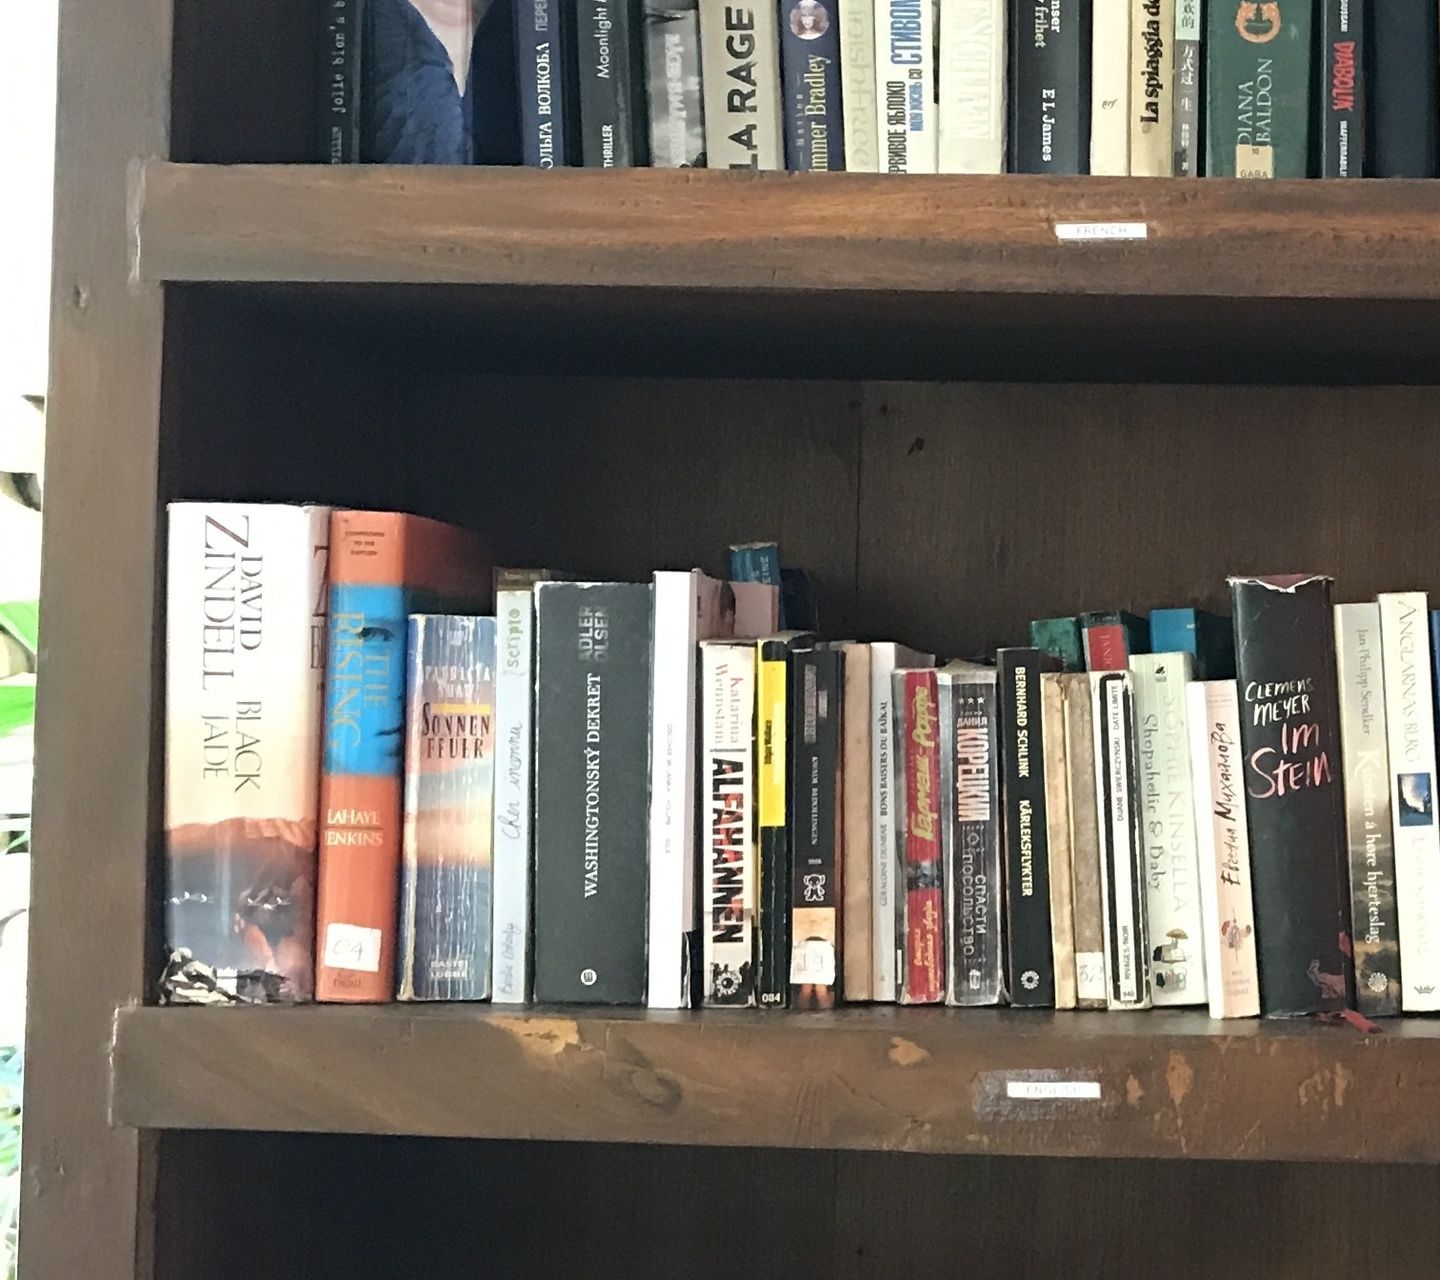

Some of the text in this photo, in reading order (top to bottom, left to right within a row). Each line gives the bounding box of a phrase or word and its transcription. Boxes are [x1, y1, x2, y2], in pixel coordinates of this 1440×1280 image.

[595, 6, 612, 79] Moonlight
[1034, 5, 1048, 48] frihet
[1140, 20, 1166, 98] spiaggia
[725, 6, 758, 170] LA RAGE
[804, 54, 831, 116] Bradley
[886, 80, 906, 126] ЯБЛОКО
[1331, 39, 1356, 112] DIABOLIK
[536, 122, 553, 168] ОЛЬГА
[601, 124, 614, 168] THRILLER
[1040, 88, 1056, 162] E L James
[1139, 100, 1158, 125] La
[1075, 225, 1129, 236] FRENCH
[202, 515, 249, 691] ZINDELL
[237, 554, 263, 652] DAVID
[330, 610, 365, 751] RISING
[1244, 677, 1314, 703] CLEMENS
[1253, 694, 1311, 727] MEYER
[201, 714, 230, 780] JADE
[233, 699, 262, 793] BLACK
[421, 700, 491, 737] SONNEN
[426, 736, 485, 759] FEUER
[581, 673, 602, 898] WASHINGTONSKÝ DEKRET
[1014, 666, 1036, 898] BERNHARD SCHLINK KÄRLEKSFLYKTER
[1362, 870, 1385, 944] hjerteslag
